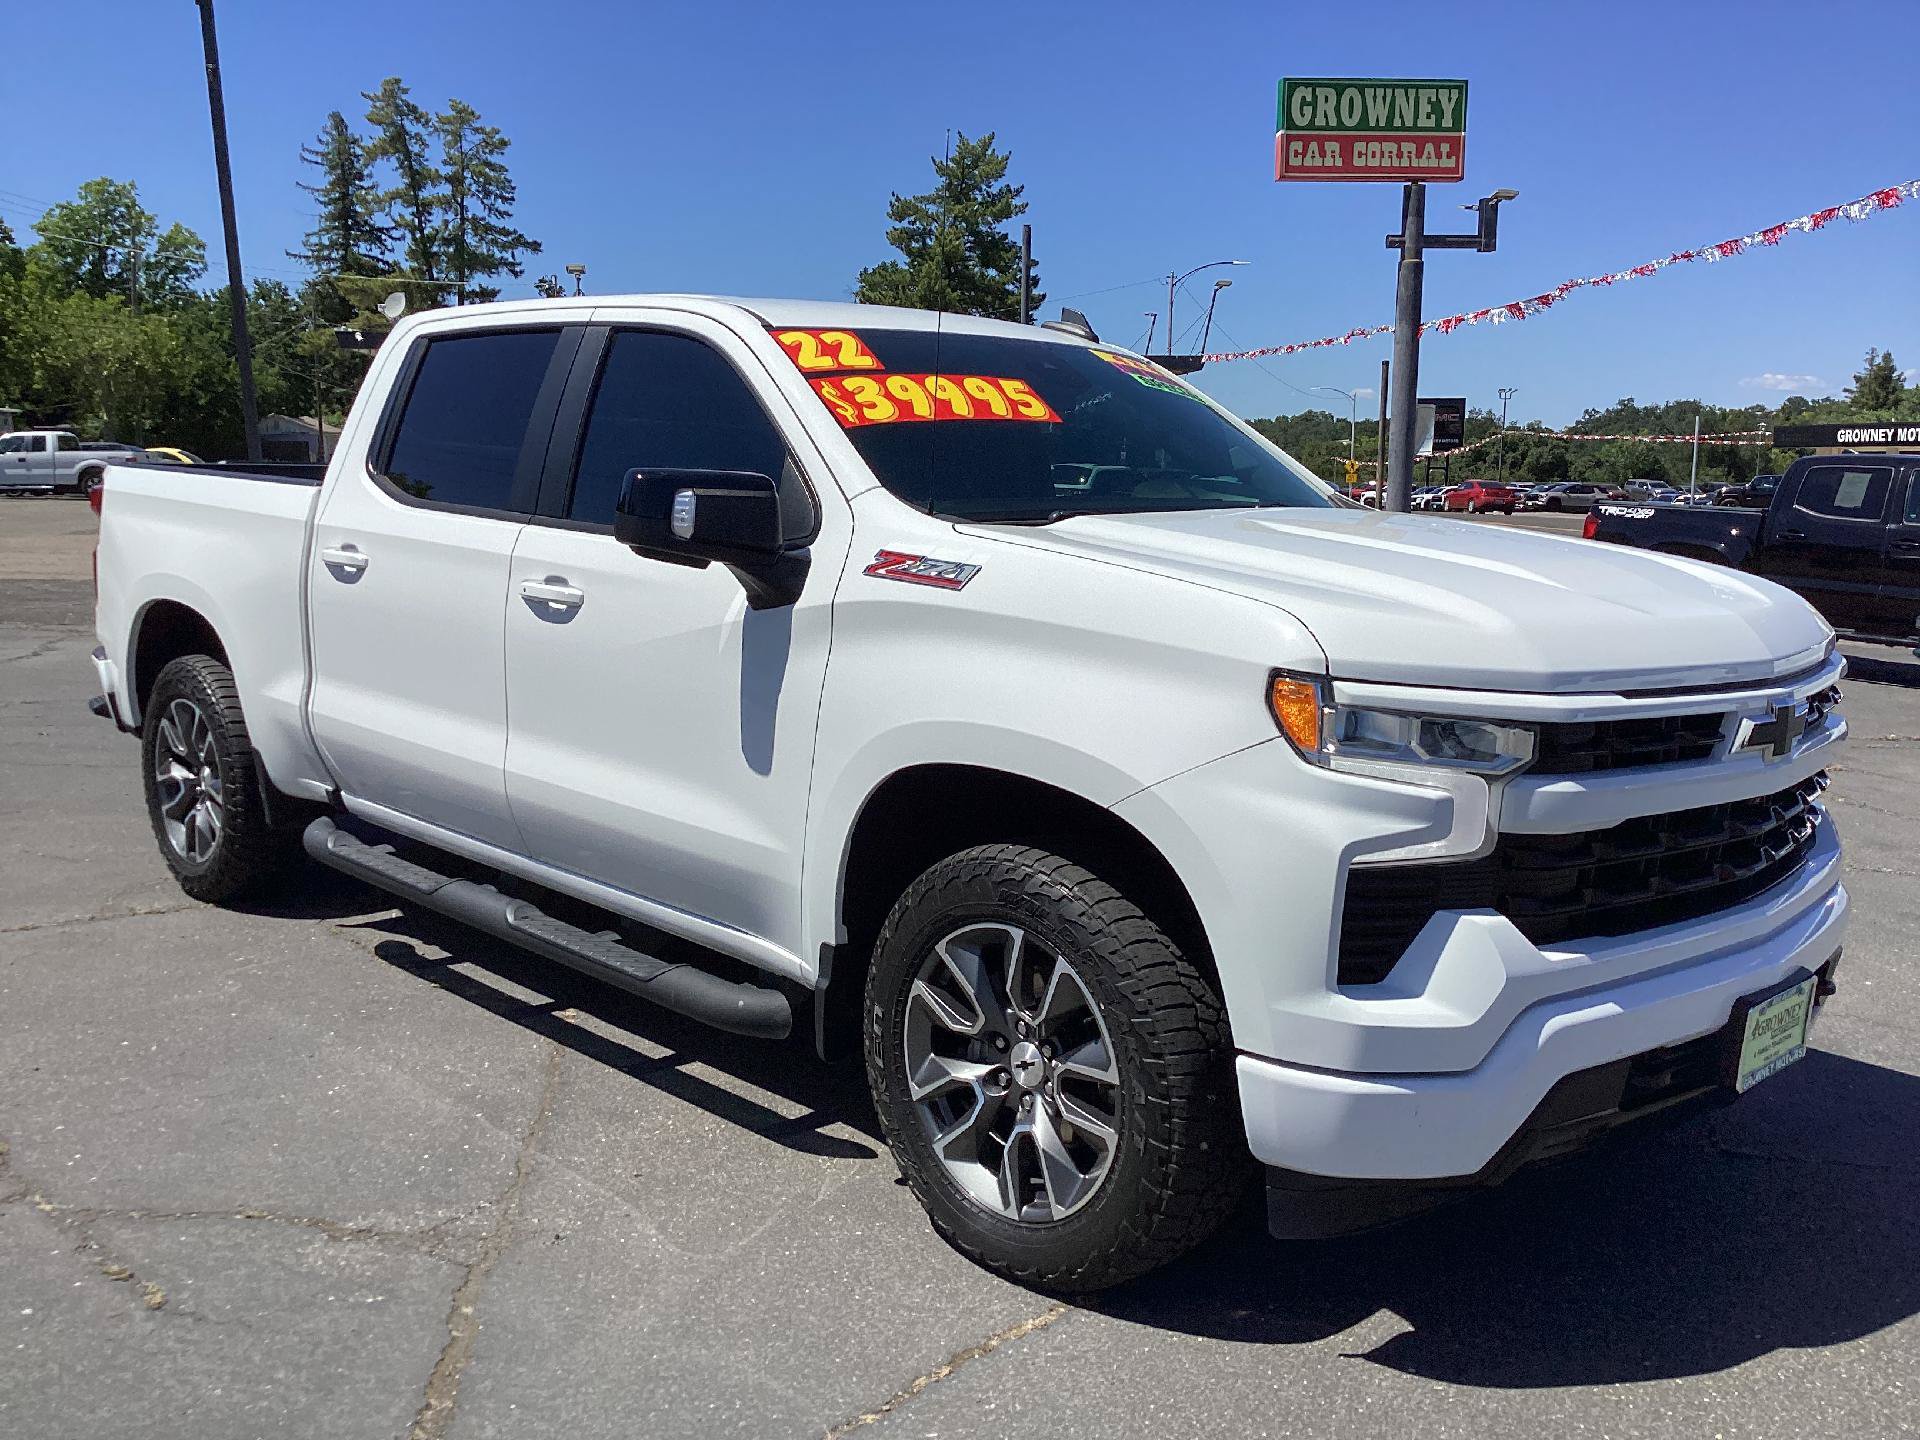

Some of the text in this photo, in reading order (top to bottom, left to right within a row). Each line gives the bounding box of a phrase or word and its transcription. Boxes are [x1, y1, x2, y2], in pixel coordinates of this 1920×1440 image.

[1290, 85, 1459, 128] GROWNEY
[1288, 140, 1456, 168] CAR CORRAL
[779, 331, 877, 370] 22
[819, 374, 1053, 424] $39995
[1837, 428, 1895, 443] GROWNEY
[862, 549, 983, 592] Z71
